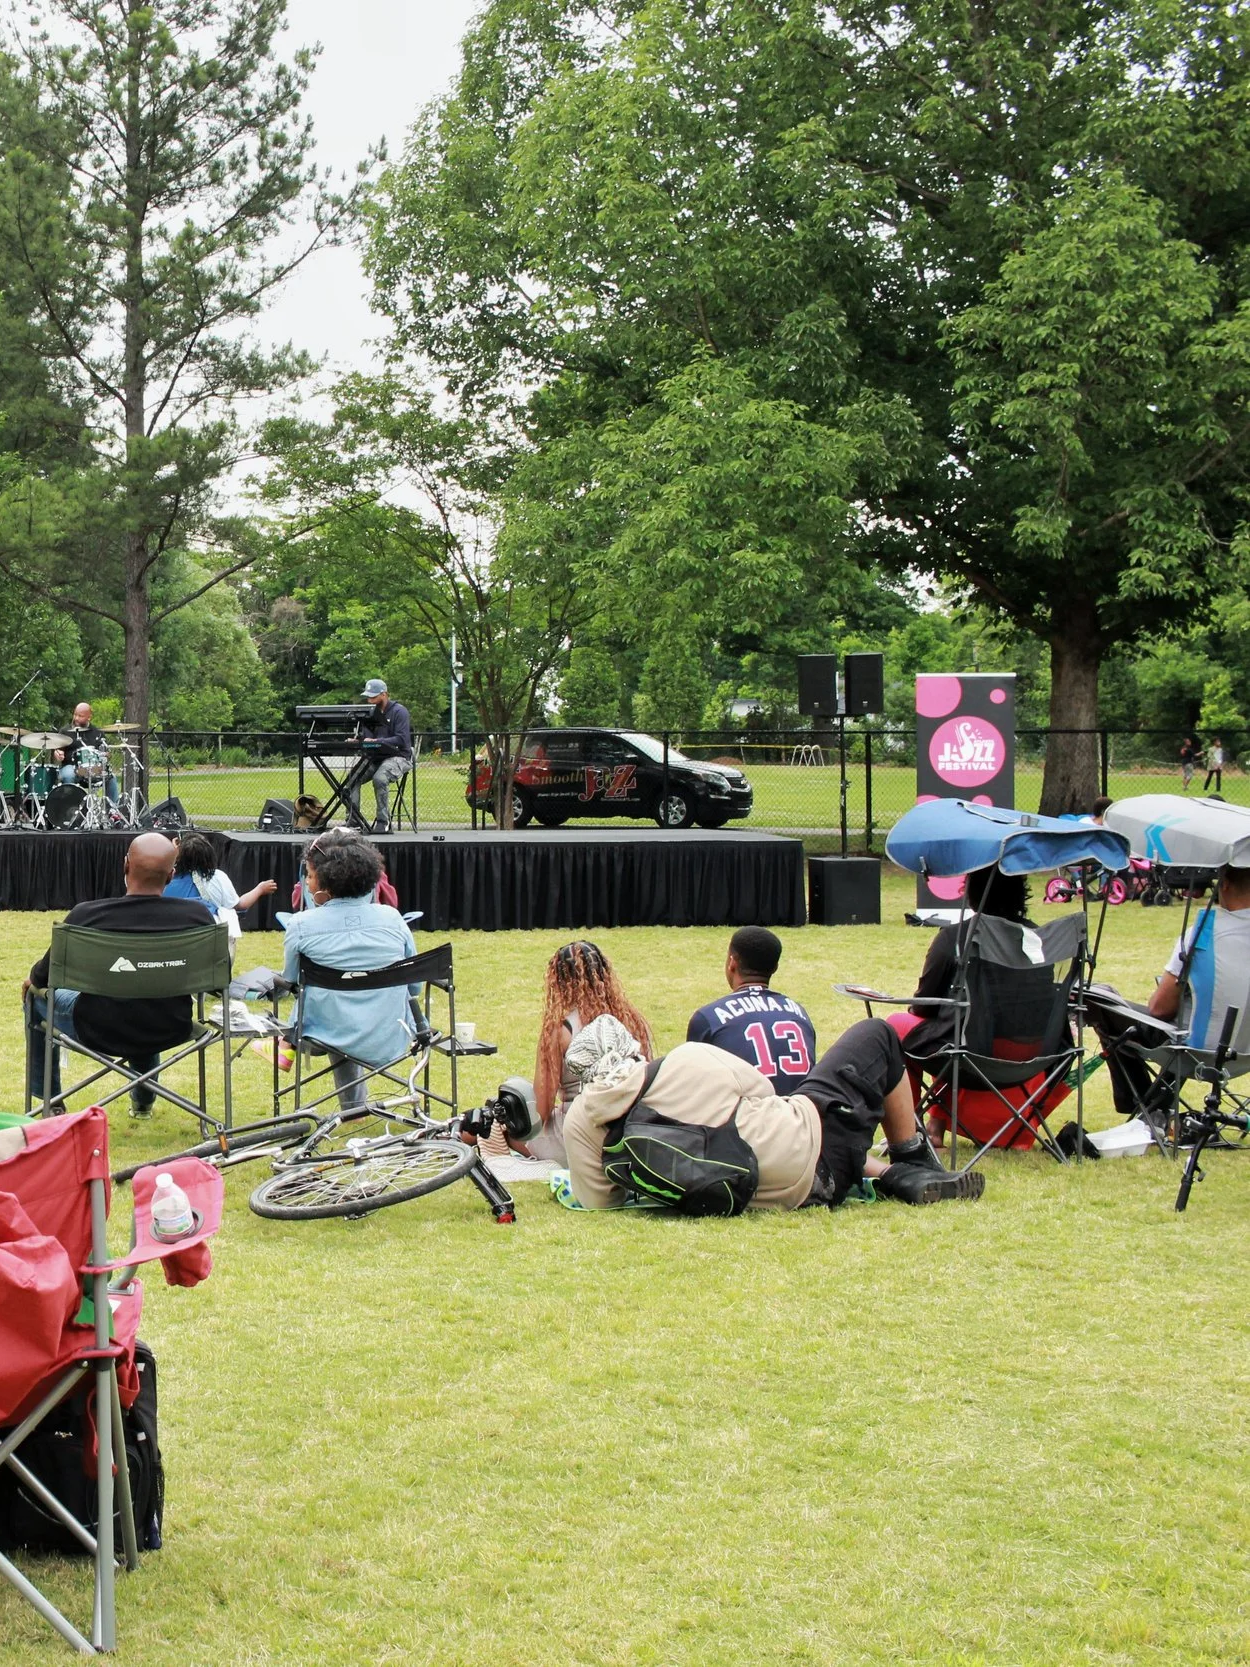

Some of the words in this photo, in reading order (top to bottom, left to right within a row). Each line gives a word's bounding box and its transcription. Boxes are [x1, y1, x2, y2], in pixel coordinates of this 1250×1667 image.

[938, 728, 995, 762] JAZZ
[938, 762, 996, 771] FESTIVAL
[713, 991, 783, 1025] ACUÑA
[744, 1020, 810, 1077] 13
